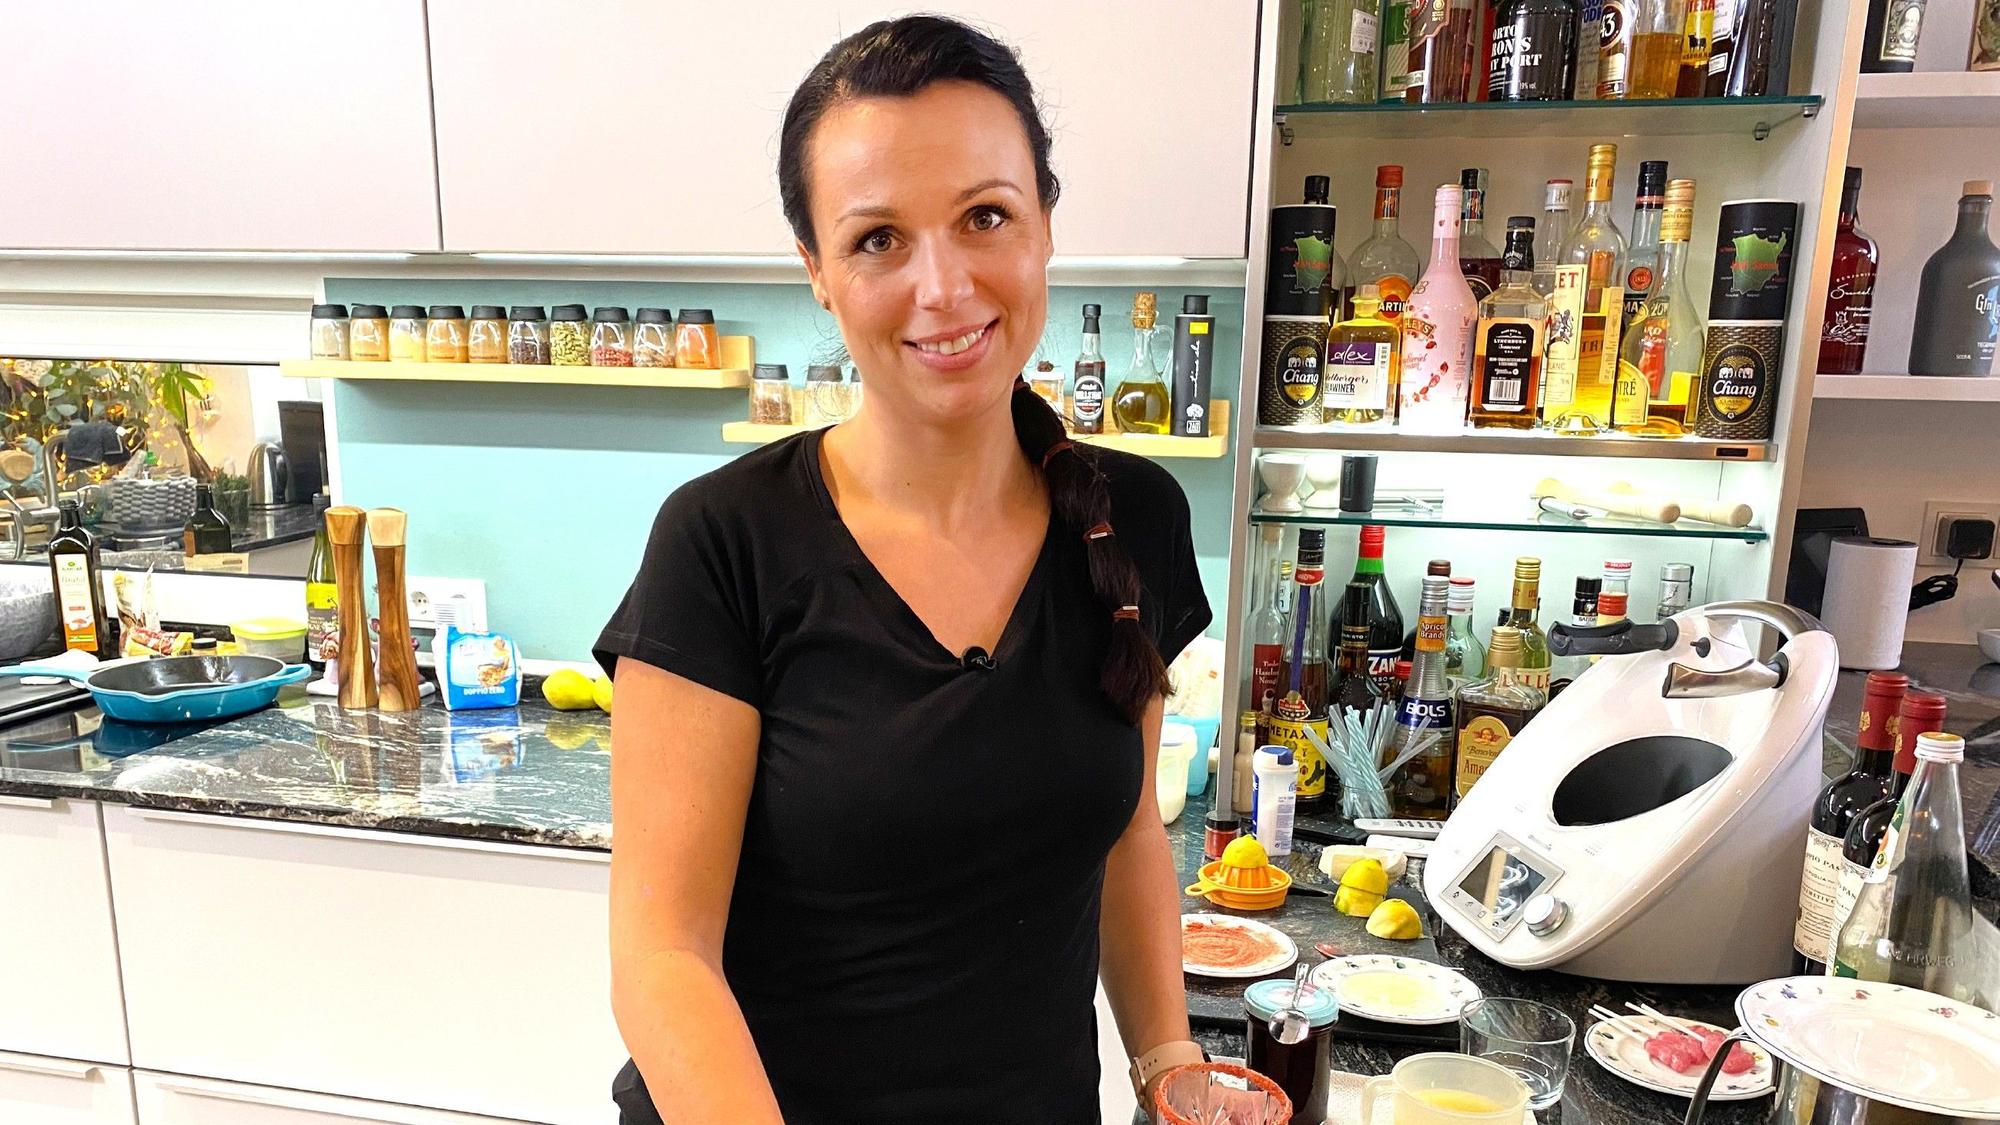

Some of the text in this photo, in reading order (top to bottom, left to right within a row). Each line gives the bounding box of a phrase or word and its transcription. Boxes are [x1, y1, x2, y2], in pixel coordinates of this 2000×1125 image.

[1501, 53, 1543, 69] PORT
[1283, 368, 1319, 386] Chang
[1713, 378, 1757, 401] Chang
[1367, 656, 1401, 676] ZAN
[1405, 701, 1447, 718] BOLS
